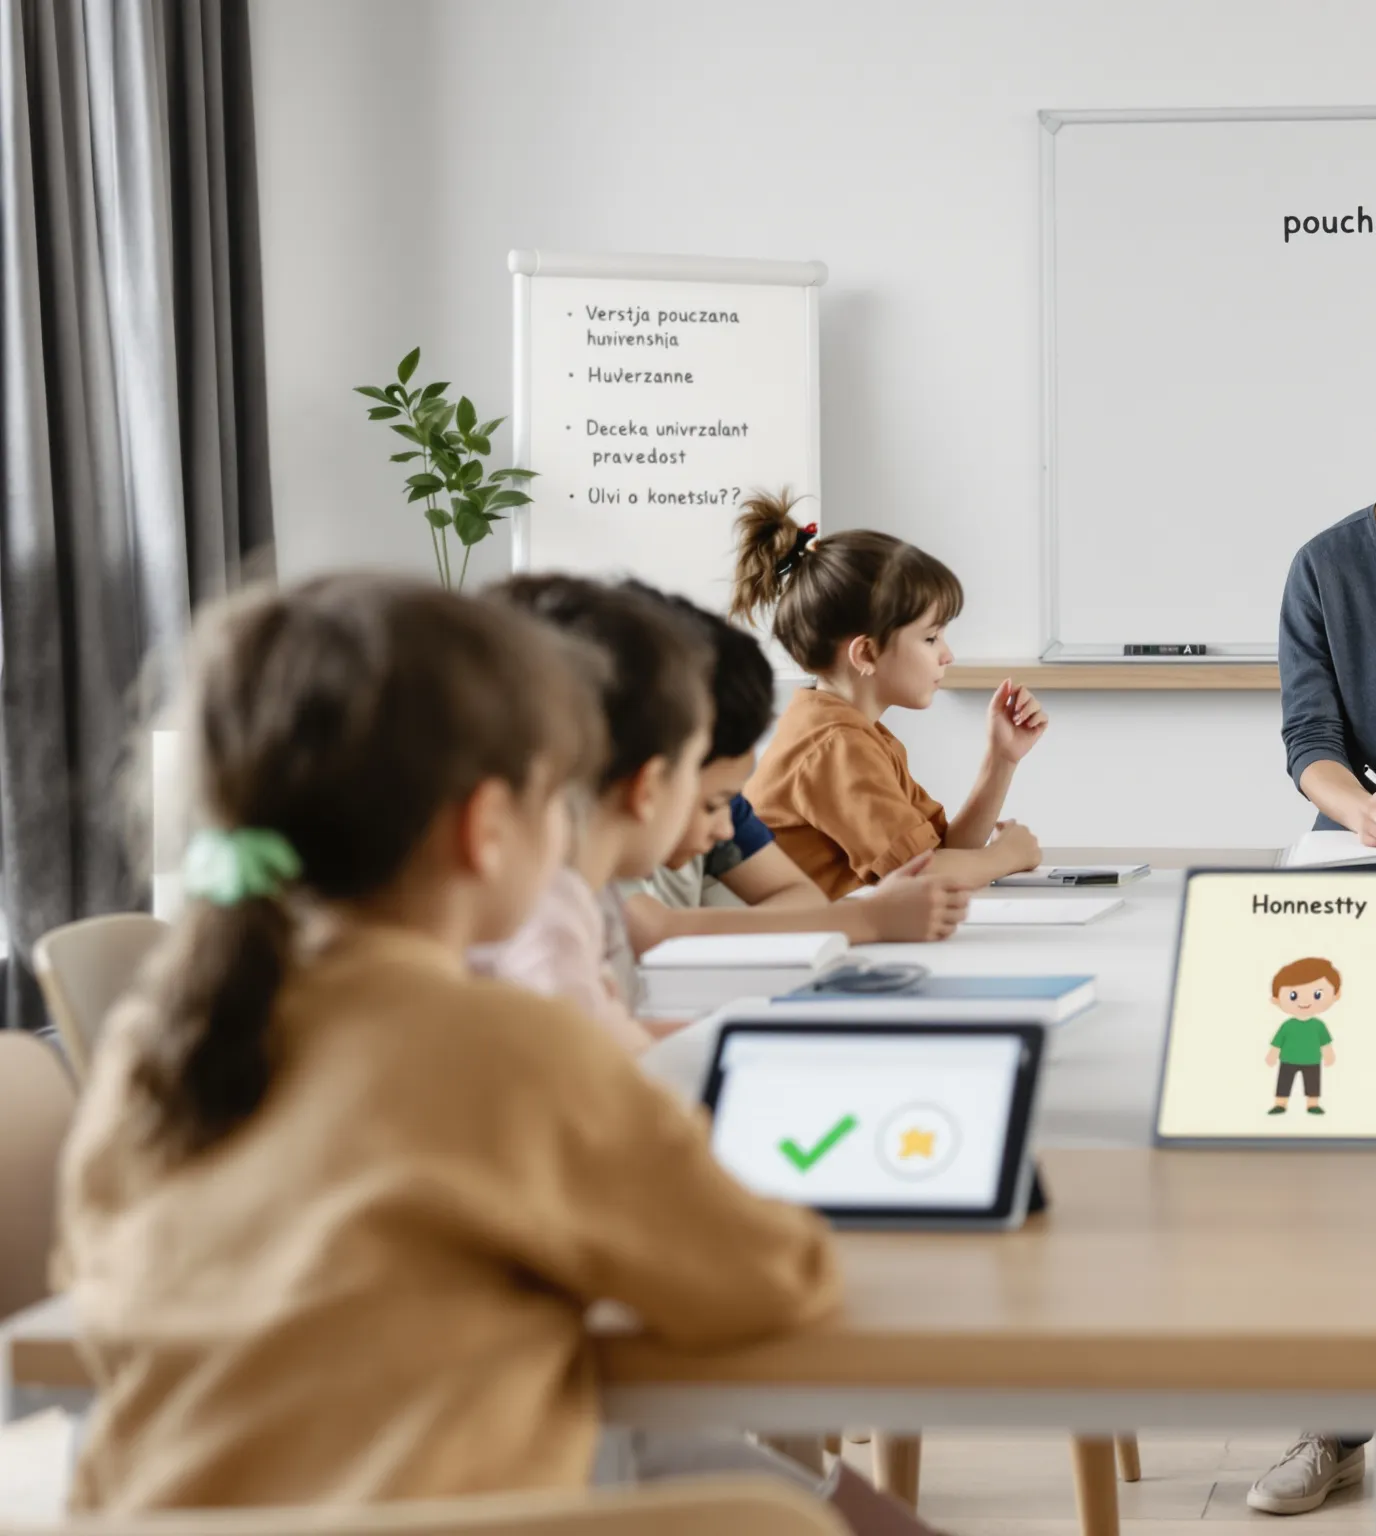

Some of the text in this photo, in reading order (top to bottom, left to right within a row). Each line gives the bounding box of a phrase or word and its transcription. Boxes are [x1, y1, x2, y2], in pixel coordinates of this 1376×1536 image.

[657, 310, 740, 327] pouczana
[586, 418, 649, 437] Deceka
[592, 447, 687, 467] pravedost
[1252, 893, 1368, 920] Honnestty
